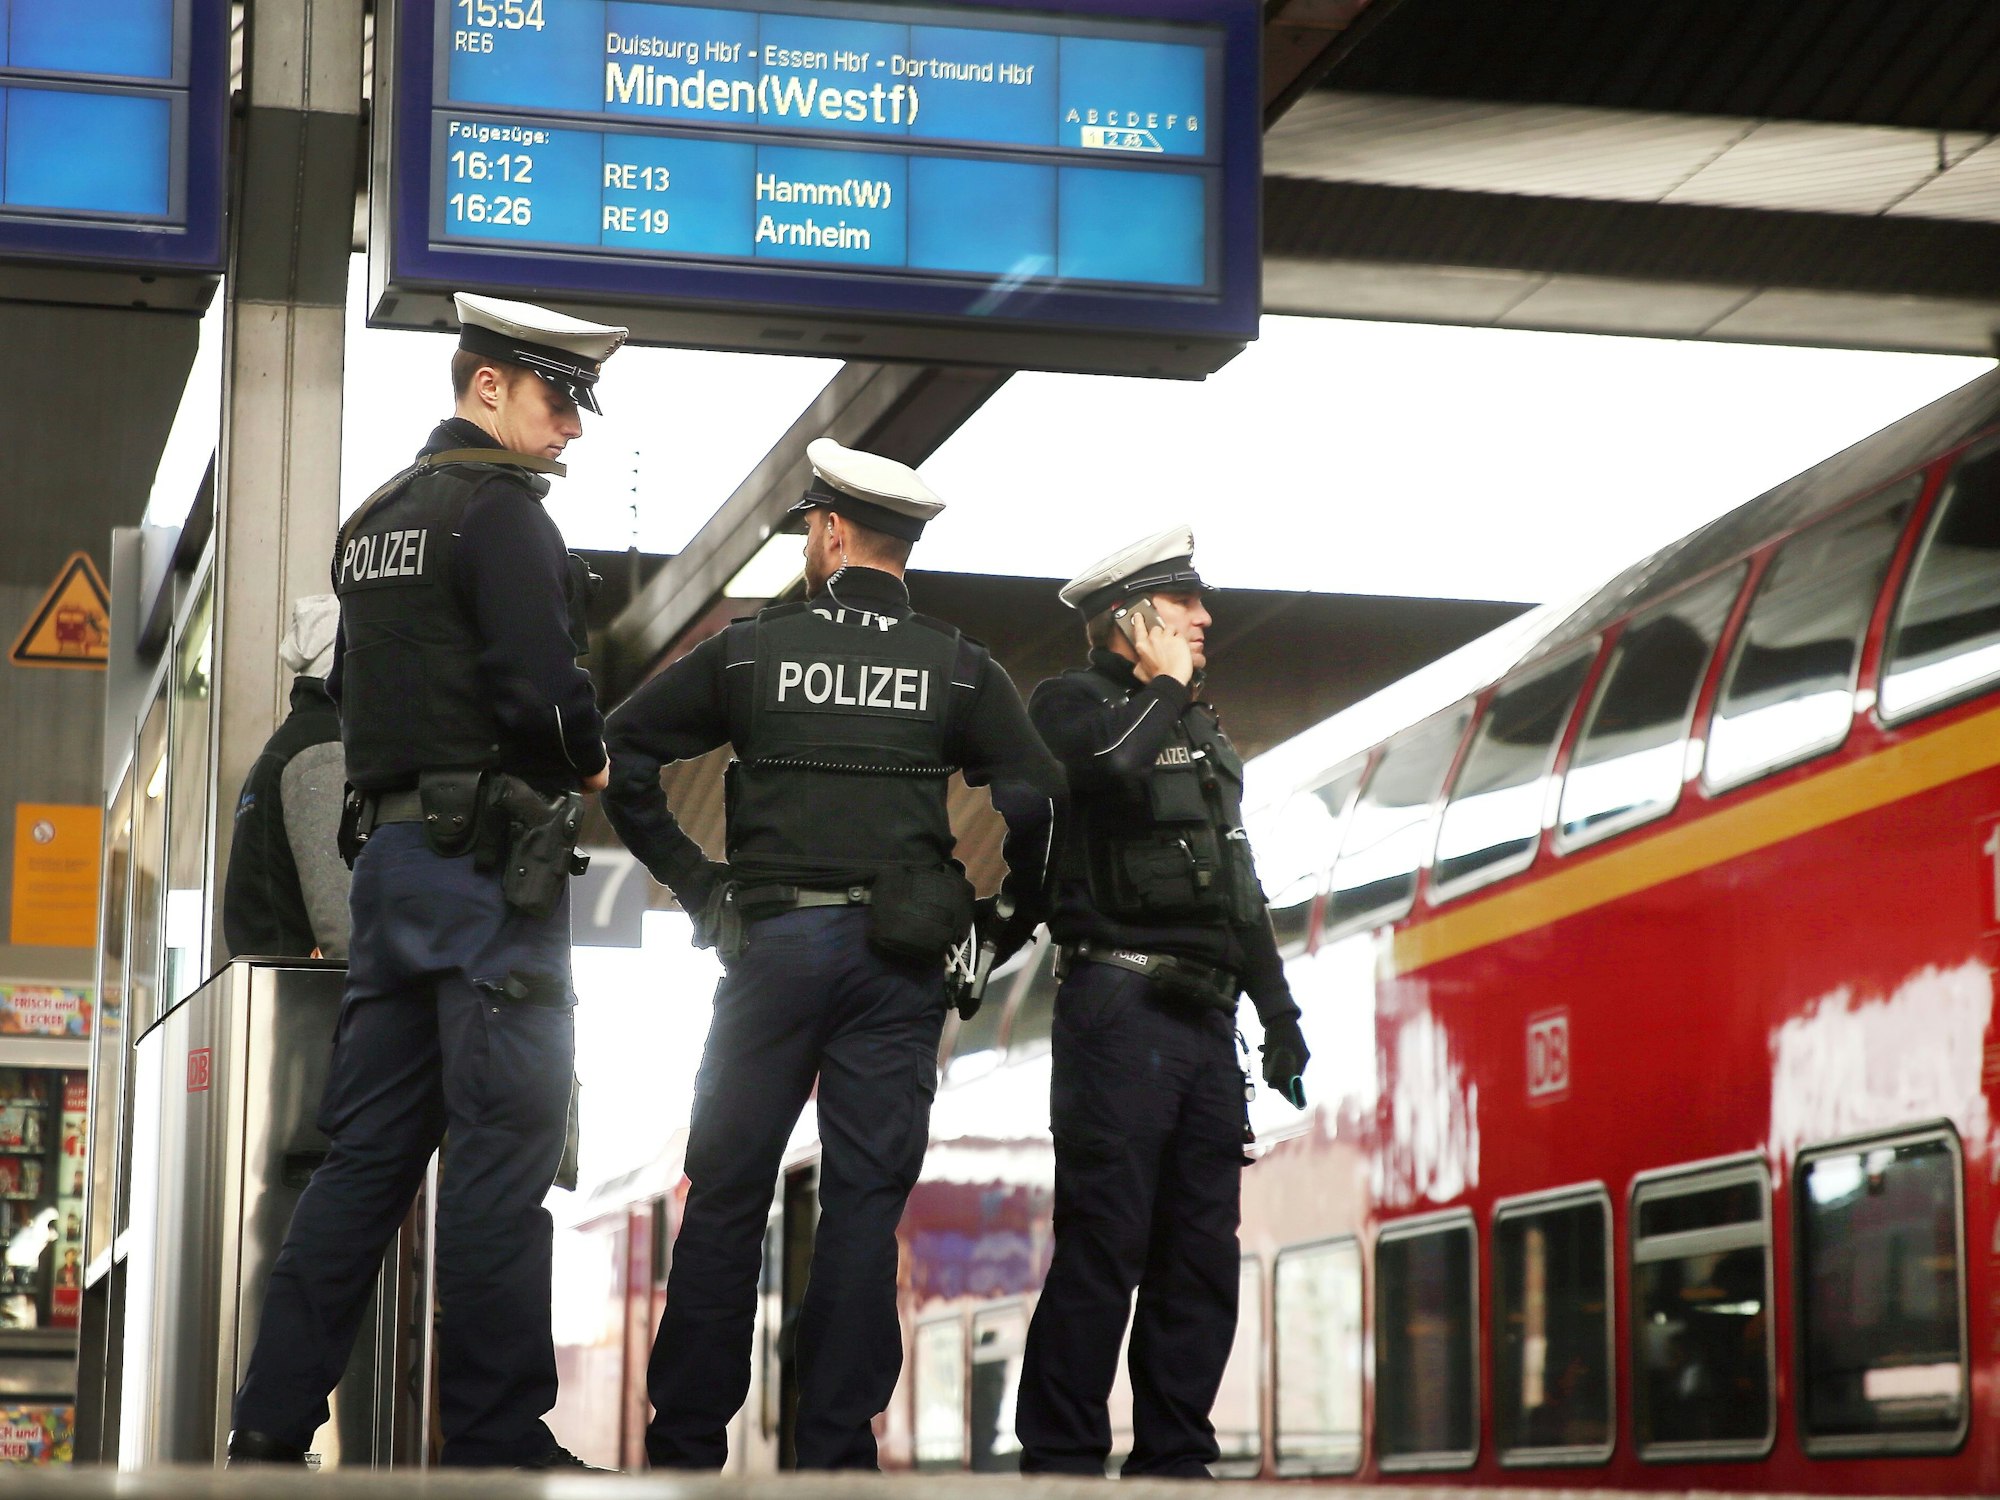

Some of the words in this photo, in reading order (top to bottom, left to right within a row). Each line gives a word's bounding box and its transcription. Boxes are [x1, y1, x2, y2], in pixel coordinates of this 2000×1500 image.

[456, 0, 546, 32] 15:54
[455, 30, 494, 54] RE6
[606, 33, 699, 65] Duisburg
[704, 41, 742, 64] Hbf
[764, 45, 828, 71] Essen
[833, 50, 870, 73] Hbf
[890, 54, 994, 83] Dortmund
[998, 63, 1035, 86] Hbf
[605, 61, 920, 125] Minden(Westf)
[449, 121, 551, 145] Folgezüge:
[1065, 107, 1081, 123] A
[1086, 108, 1099, 125] B
[1107, 110, 1119, 126] C
[1126, 111, 1140, 127] D
[1146, 112, 1159, 129] E
[1167, 113, 1178, 130] F
[451, 150, 534, 184] 16:12
[756, 173, 892, 209] Hamm(W)
[450, 192, 533, 226] 16:26
[754, 215, 871, 250] Arnheim
[339, 528, 428, 585] POLIZEI
[777, 660, 930, 712] POLIZEI
[586, 848, 637, 929] 7
[188, 1053, 209, 1088] DB
[1530, 1022, 1567, 1092] DB
